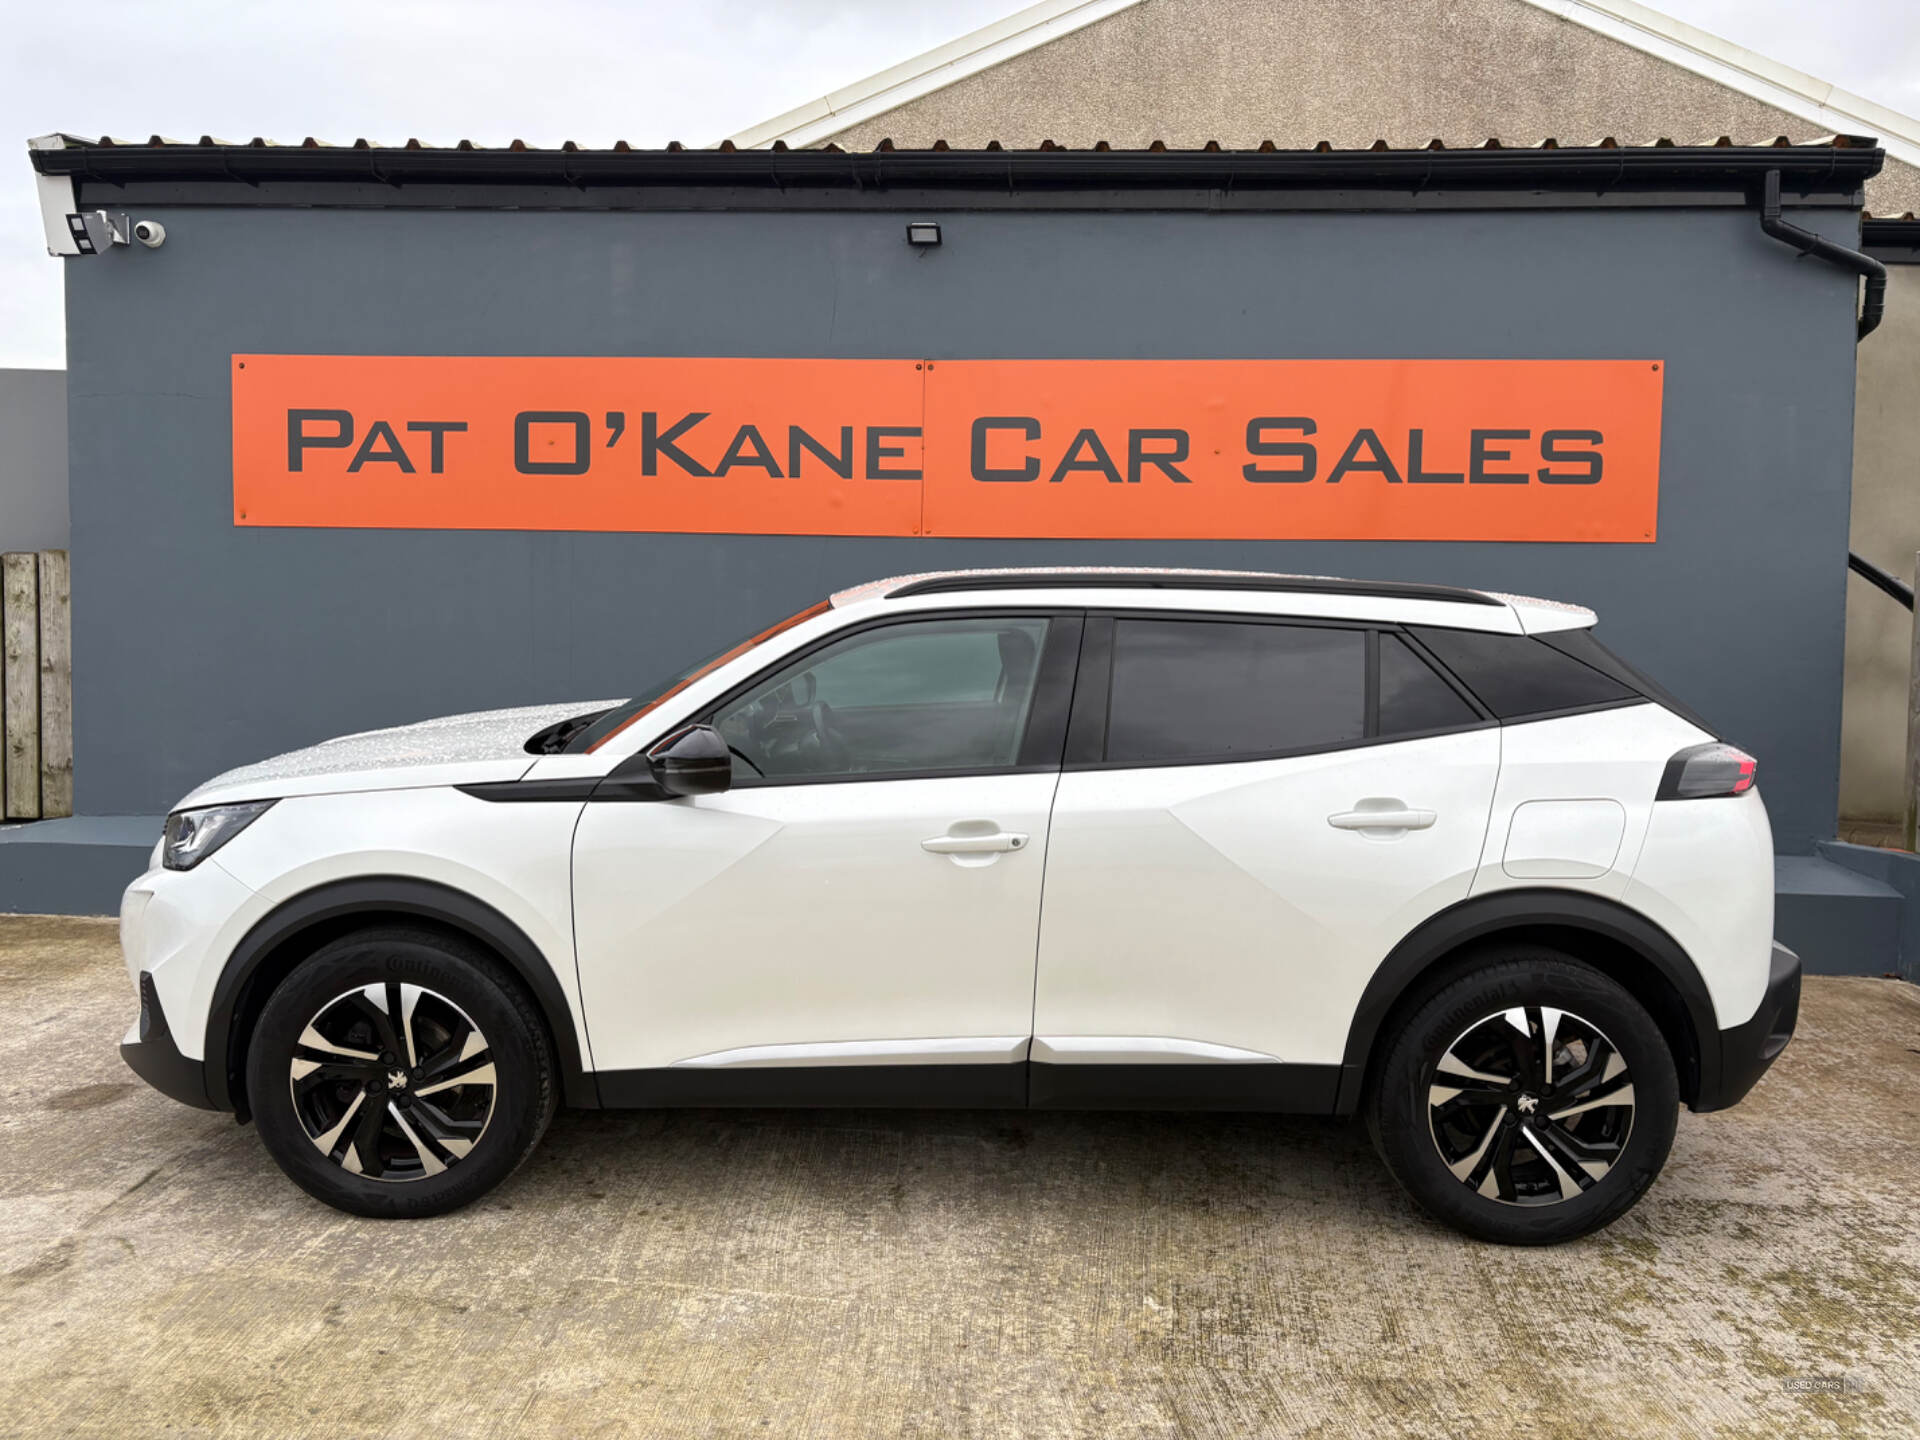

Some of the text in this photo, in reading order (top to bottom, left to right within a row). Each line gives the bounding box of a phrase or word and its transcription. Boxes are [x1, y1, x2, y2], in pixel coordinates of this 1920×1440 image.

[287, 408, 1604, 485] PAT O'KANE CAR SALES
